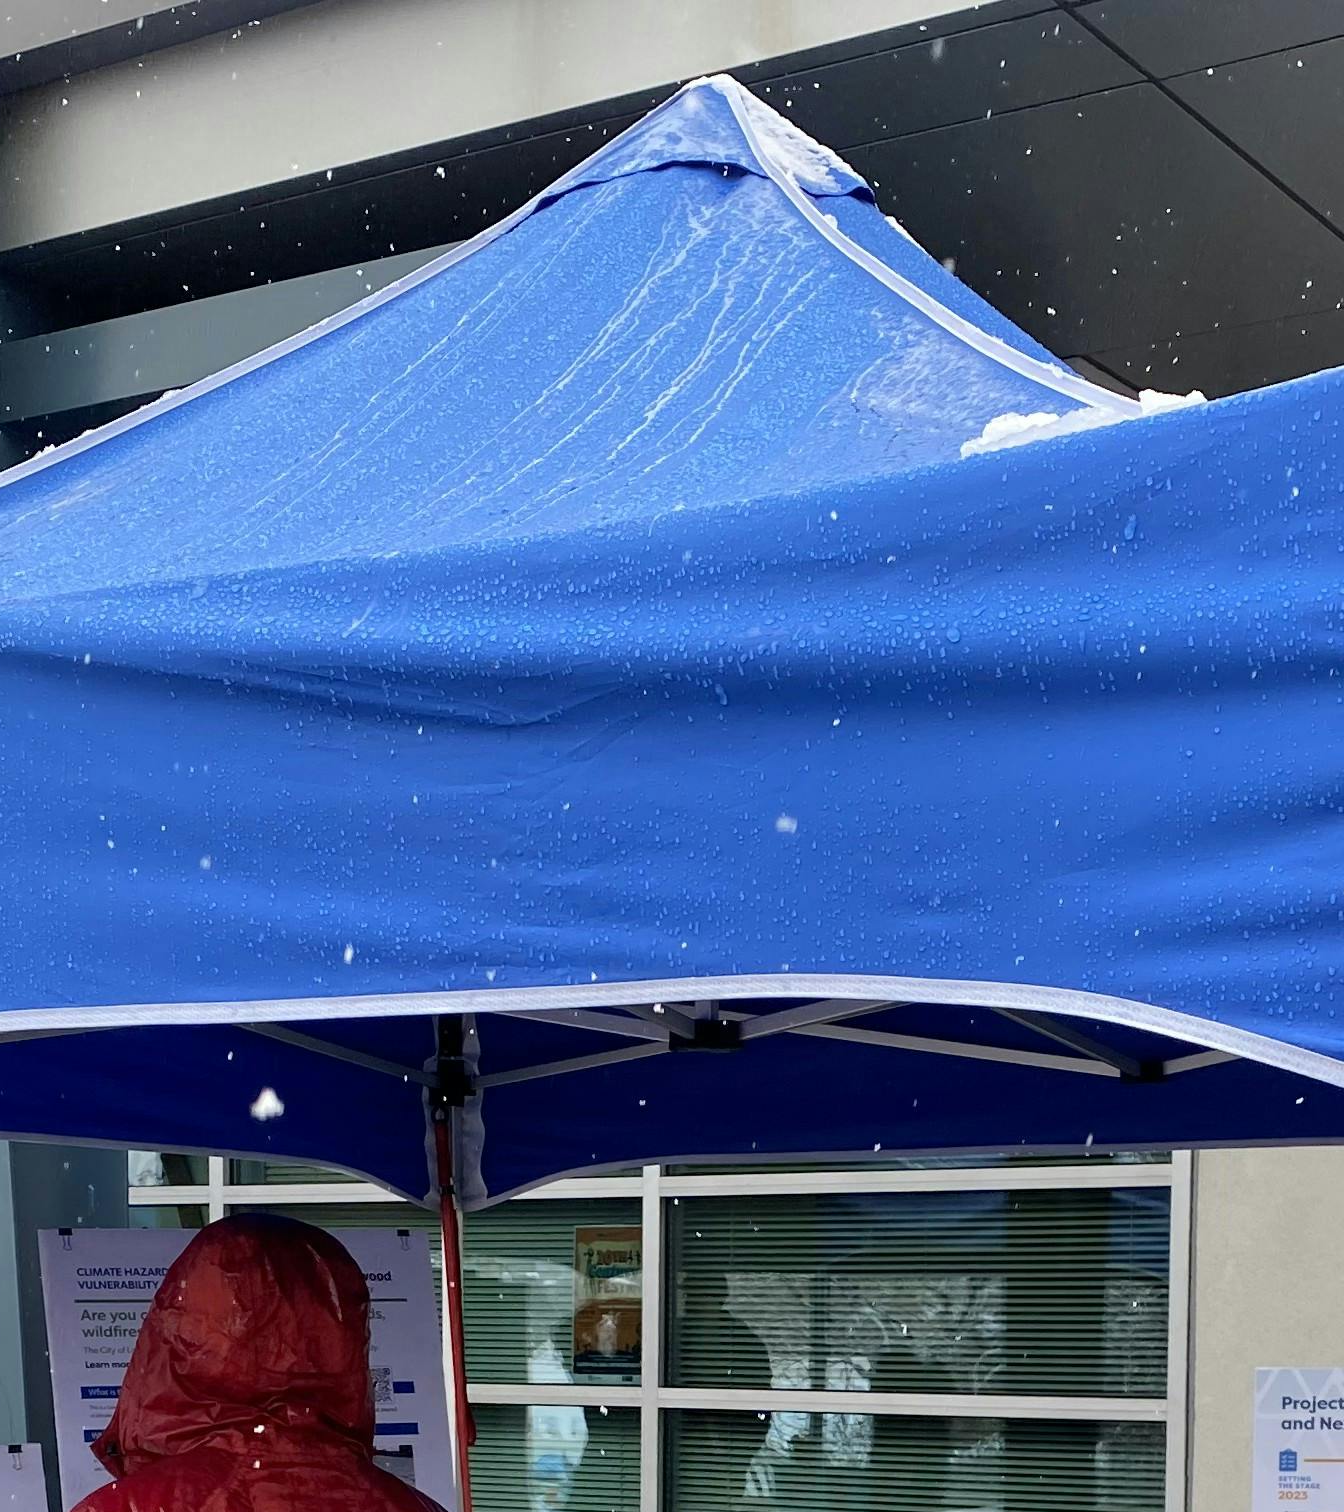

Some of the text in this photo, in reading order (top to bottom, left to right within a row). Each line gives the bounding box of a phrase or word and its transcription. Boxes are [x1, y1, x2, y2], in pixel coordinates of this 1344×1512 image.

[77, 1267, 123, 1277] CLIMATE
[78, 1281, 159, 1290] VULNERABILITY
[81, 1309, 106, 1321] Are
[111, 1311, 136, 1326] you
[82, 1325, 140, 1338] wildfire
[85, 1361, 110, 1369] Learn
[1281, 1417, 1314, 1430] and
